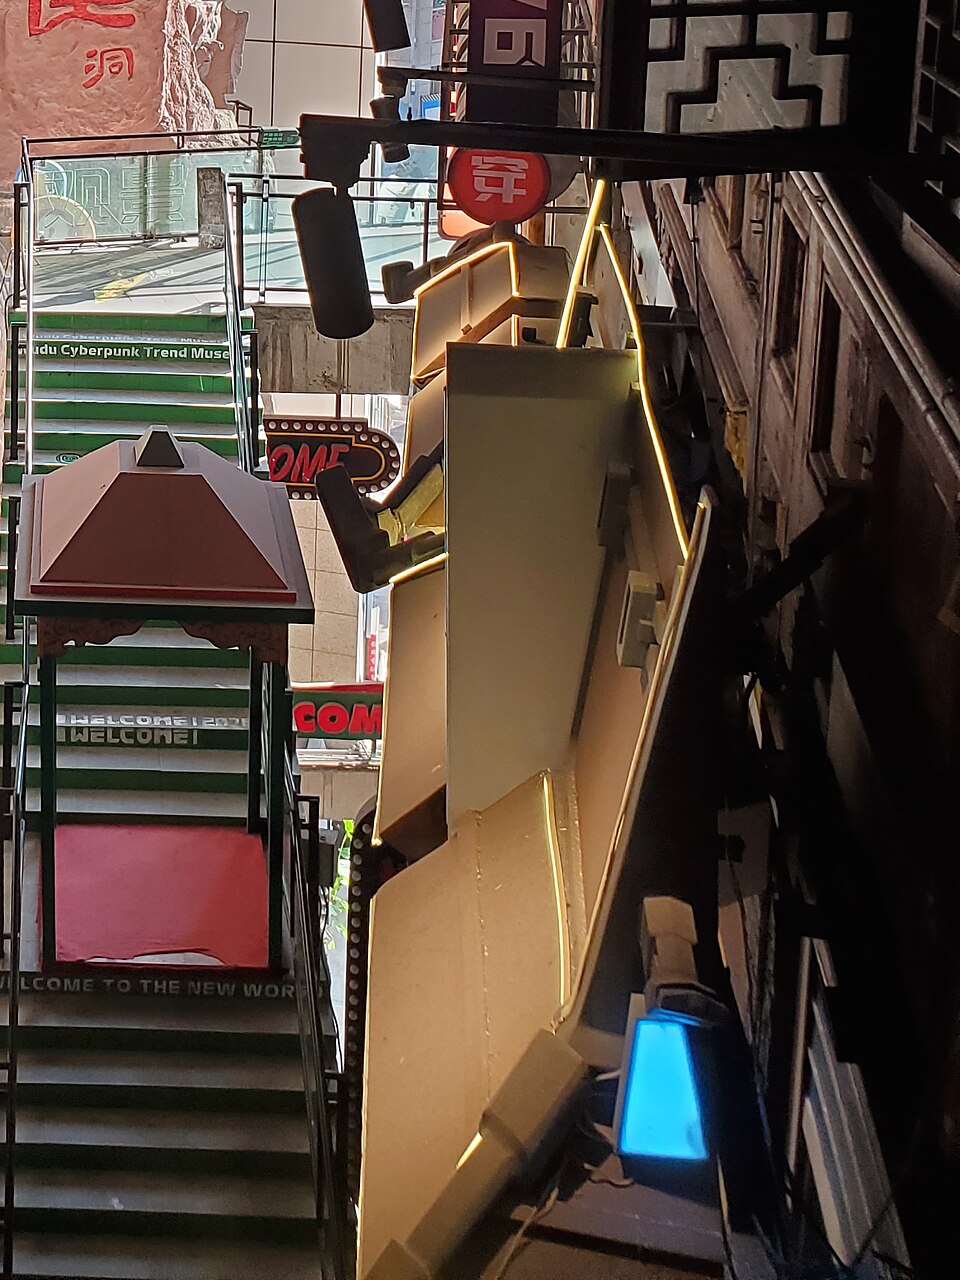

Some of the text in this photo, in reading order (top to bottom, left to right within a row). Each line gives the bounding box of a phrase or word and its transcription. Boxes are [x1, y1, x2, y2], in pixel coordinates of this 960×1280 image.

[60, 343, 140, 358] Cyberpunk
[144, 346, 188, 359] Trend
[191, 347, 230, 359] Muse
[293, 702, 382, 734] COM
[103, 978, 131, 993] TO
[140, 978, 180, 994] THE
[188, 981, 235, 997] NEW
[243, 982, 326, 1000] WOR
